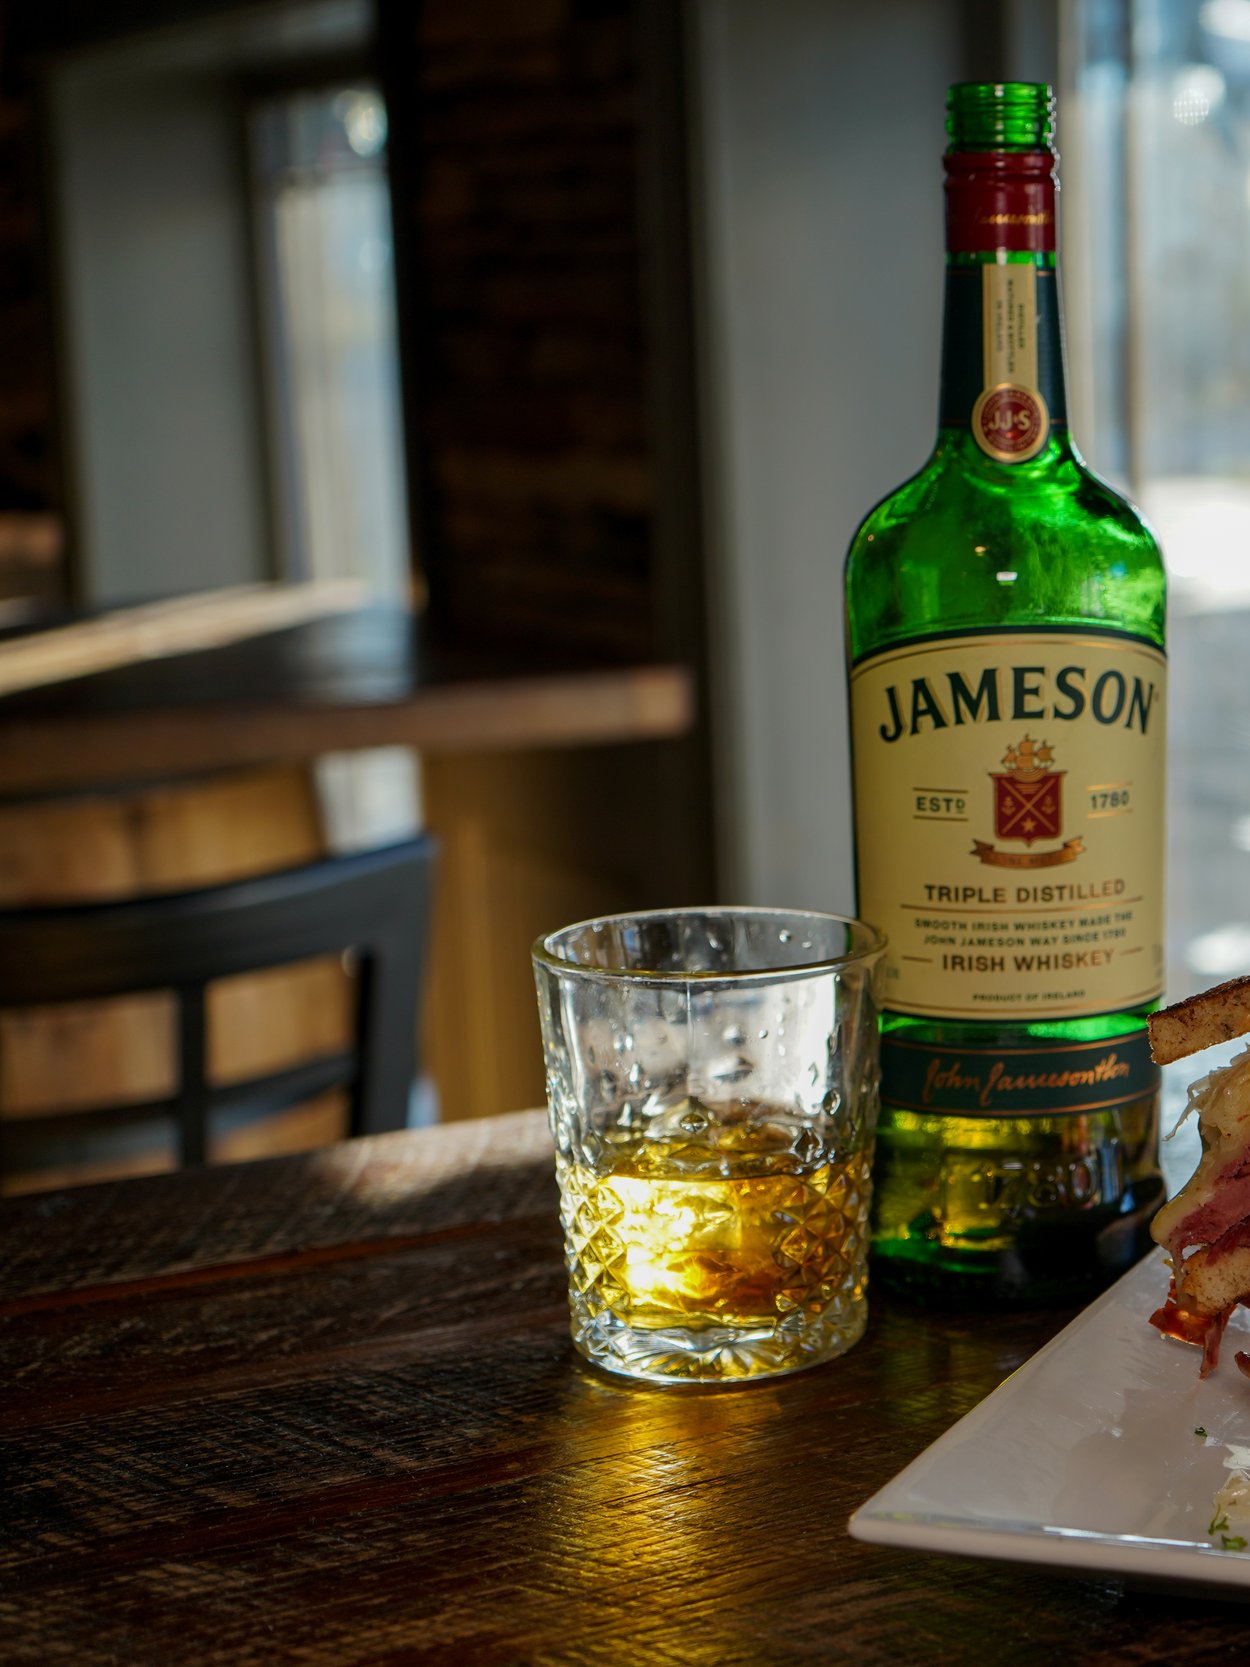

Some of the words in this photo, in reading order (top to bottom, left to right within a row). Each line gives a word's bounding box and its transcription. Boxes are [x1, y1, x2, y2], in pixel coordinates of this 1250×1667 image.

[880, 666, 1153, 743] JAMESON
[1091, 791, 1130, 810] 1780
[924, 884, 1006, 903] TRIPLE
[1016, 878, 1126, 903] DISTILLED
[914, 918, 967, 931] SMOOTH
[972, 920, 1009, 931] IRISH
[1014, 918, 1075, 931] WHISKEY
[1079, 914, 1111, 928] MADE
[1114, 911, 1133, 922] THE
[923, 936, 956, 946] JOHN
[960, 936, 1025, 947] JAMESON
[1029, 935, 1058, 946] WAY
[1063, 933, 1099, 944] SINCE
[1102, 928, 1127, 940] 1780
[942, 953, 1004, 972] IRISH
[1014, 948, 1115, 972] WHISKEY
[972, 992, 1022, 1002] PRODUCT
[1024, 992, 1039, 1001] OF
[1040, 989, 1086, 1001] IRELAND
[923, 1058, 979, 1104] John
